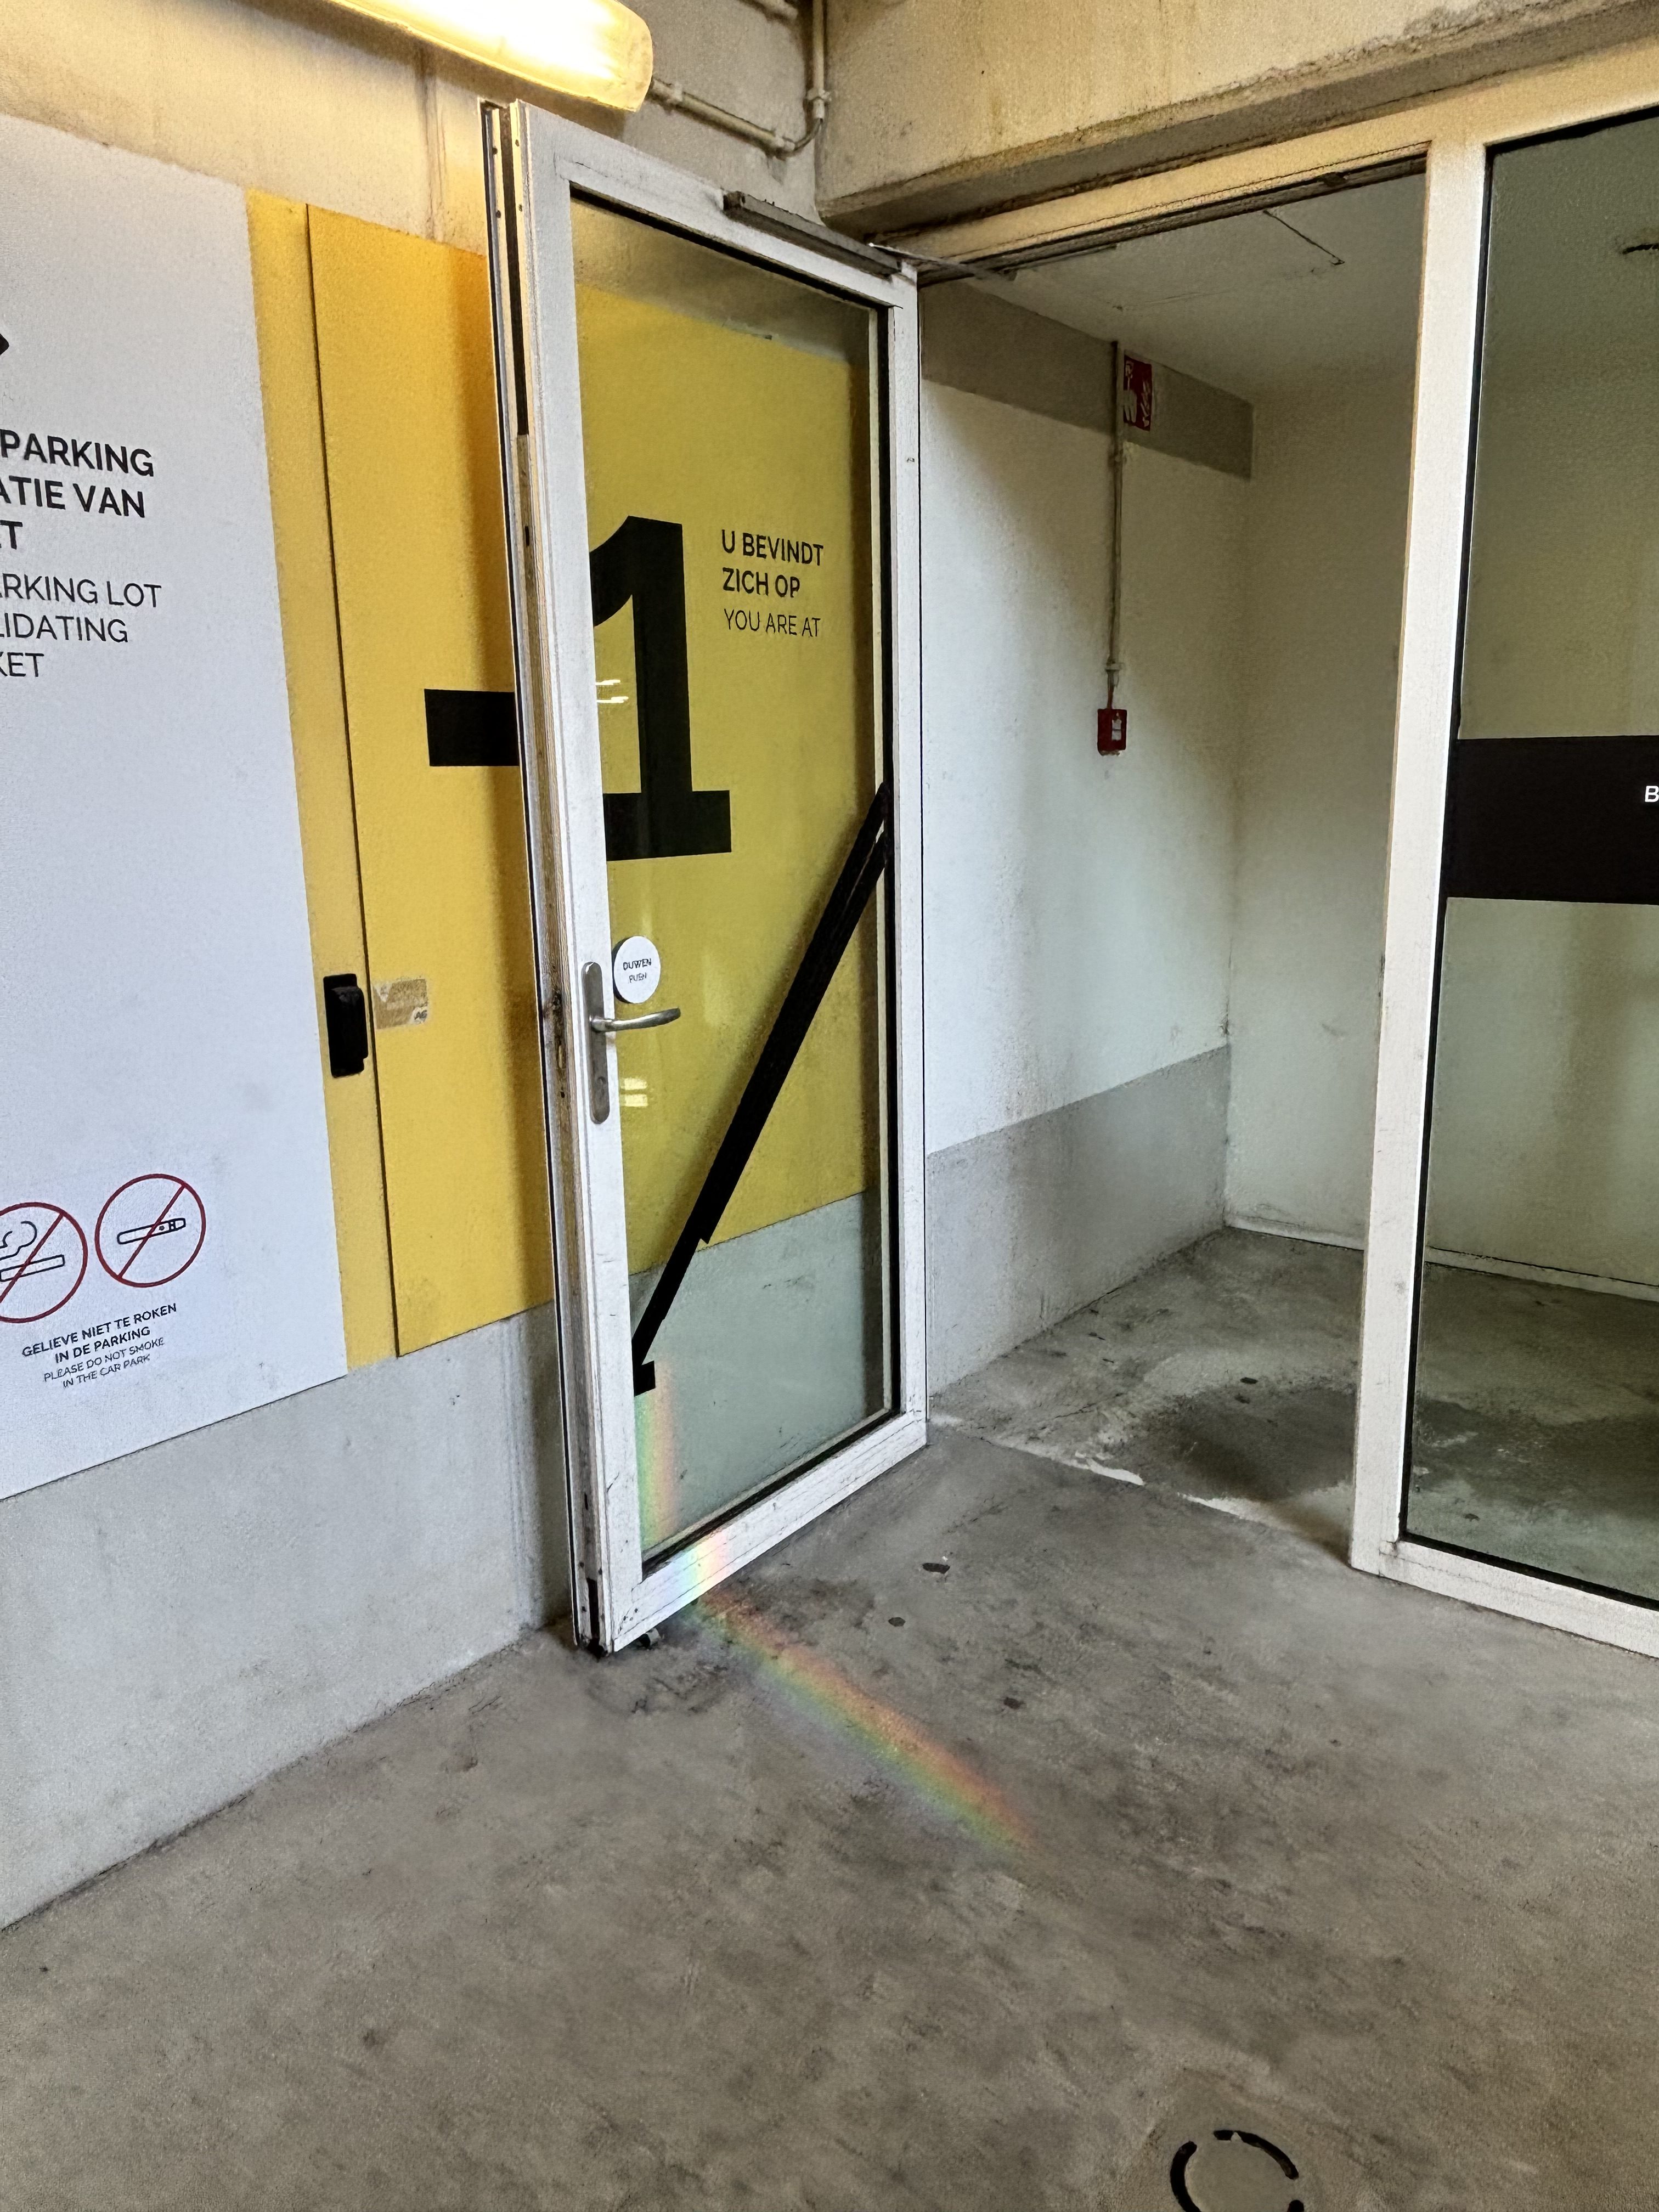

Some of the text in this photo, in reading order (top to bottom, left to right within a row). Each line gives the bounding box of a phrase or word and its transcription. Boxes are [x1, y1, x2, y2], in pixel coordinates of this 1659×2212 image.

[0, 428, 154, 477] PARKING
[73, 484, 145, 518] VAN
[721, 529, 823, 566] U BEVINDT
[0, 573, 162, 608] RKING LOT
[722, 567, 800, 598] ZICH OP
[724, 608, 821, 637] YOU ARE AT
[623, 958, 651, 970] DUWEN
[22, 1302, 177, 1357] GELIEVE NIET TE ROKEN
[55, 1326, 151, 1364] IN DE PARKING
[43, 1337, 165, 1383] PLEASE DO NOT SMOKE
[63, 1353, 151, 1389] IN THE CAR PARK
